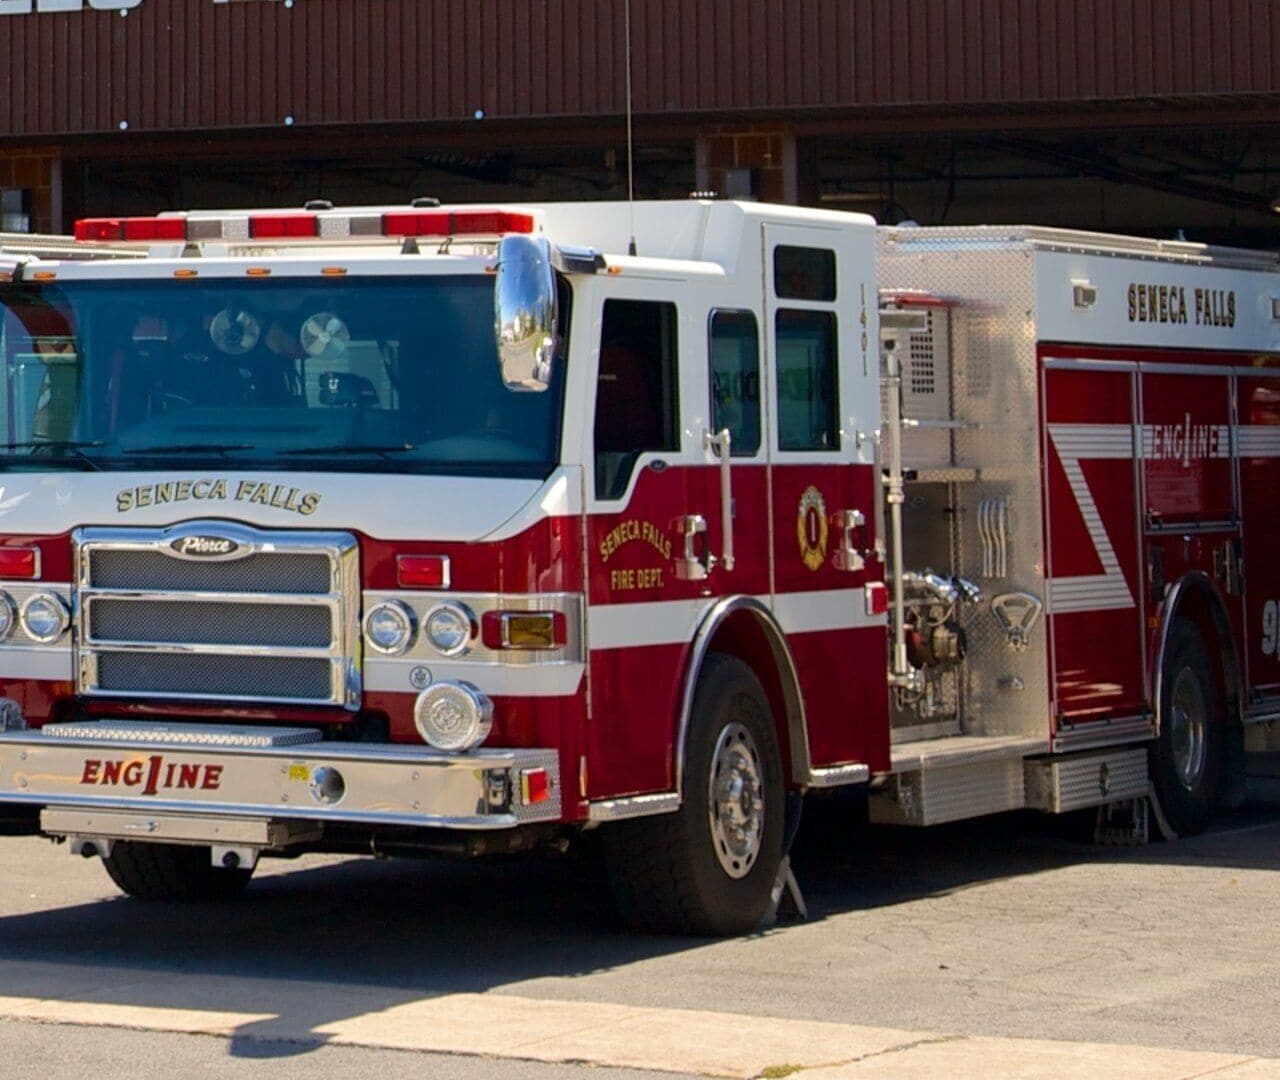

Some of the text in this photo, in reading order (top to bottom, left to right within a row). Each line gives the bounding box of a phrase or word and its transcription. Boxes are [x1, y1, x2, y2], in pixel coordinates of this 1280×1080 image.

[1127, 283, 1236, 329] SENECA FALLS
[117, 478, 323, 516] SENECA FALLS
[181, 536, 231, 554] Pierce
[600, 519, 672, 563] SENECA FALLS
[611, 568, 665, 591] FIRE DEPT.
[1262, 600, 1280, 662] 9
